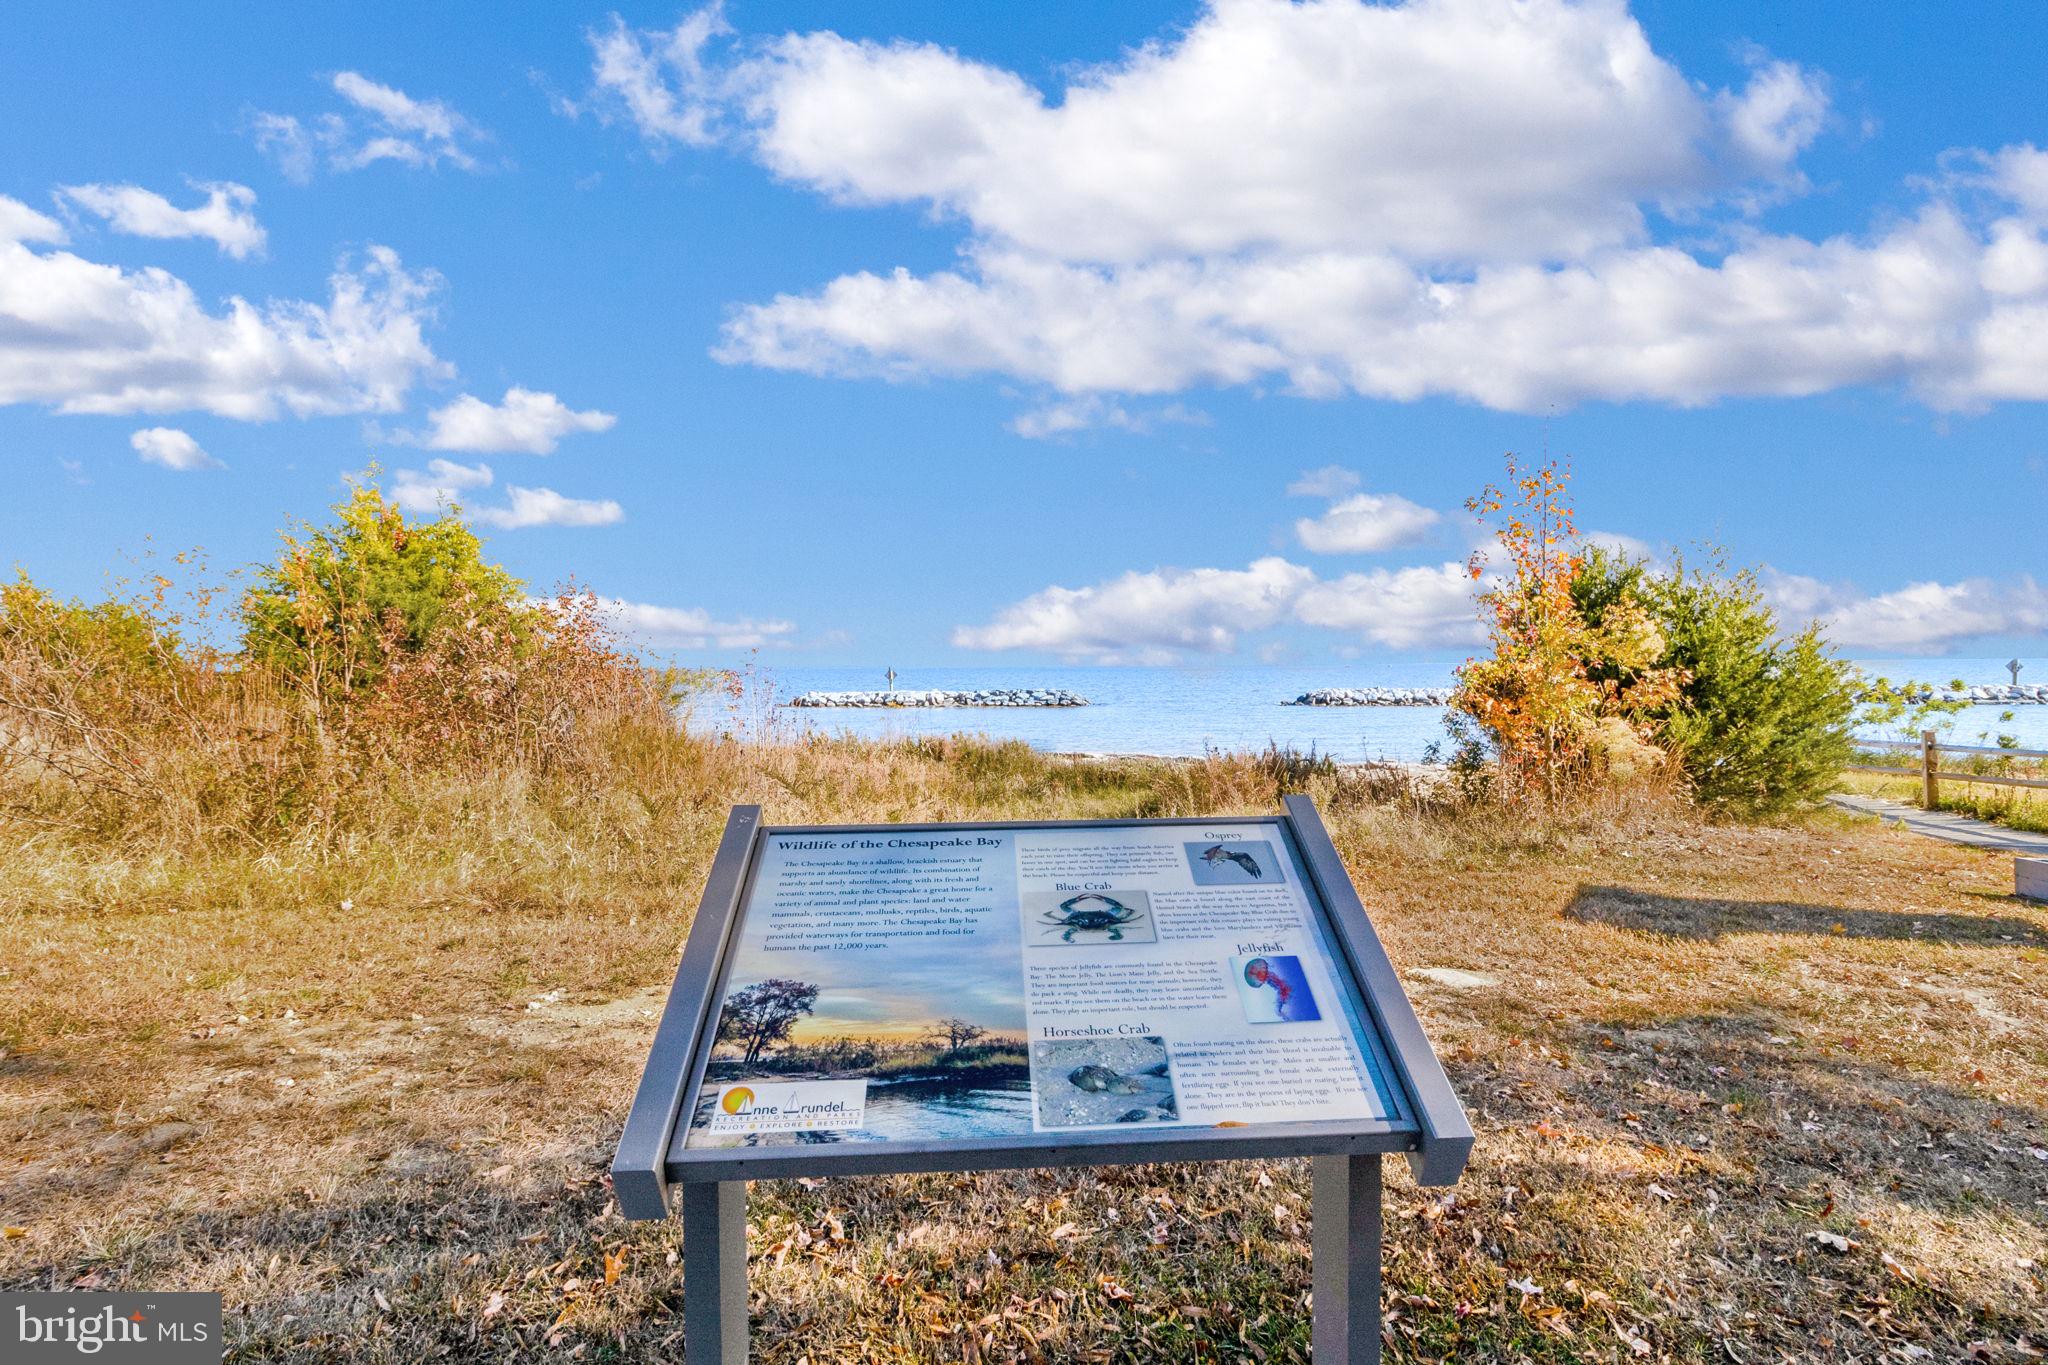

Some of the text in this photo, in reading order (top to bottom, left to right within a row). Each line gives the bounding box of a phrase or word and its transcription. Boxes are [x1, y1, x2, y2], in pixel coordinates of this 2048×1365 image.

[1204, 832, 1242, 842] Osprey
[777, 841, 838, 851] Wildlife
[841, 841, 860, 849] of
[888, 839, 972, 850] Chesapeake
[976, 838, 1002, 848] Bay
[801, 860, 845, 869] Chesapeake
[779, 880, 808, 889] marshy
[825, 879, 847, 888] sandy
[892, 878, 913, 886] along
[1056, 882, 1112, 891] Blue Crab
[876, 888, 922, 896] Chesapeake
[774, 901, 803, 909] variety
[859, 898, 880, 907] plant
[964, 907, 992, 915] aquatic
[901, 918, 948, 928] Chesapeake
[948, 918, 964, 926] Bay
[766, 933, 804, 943] provided
[806, 932, 850, 942] waterways
[865, 930, 924, 940] transportation
[813, 944, 831, 953] past
[834, 943, 864, 951] 12,000
[1236, 942, 1284, 956] Jellyfish
[1042, 1024, 1151, 1038] Horseshoe Crab
[714, 1124, 746, 1132] ENJOY
